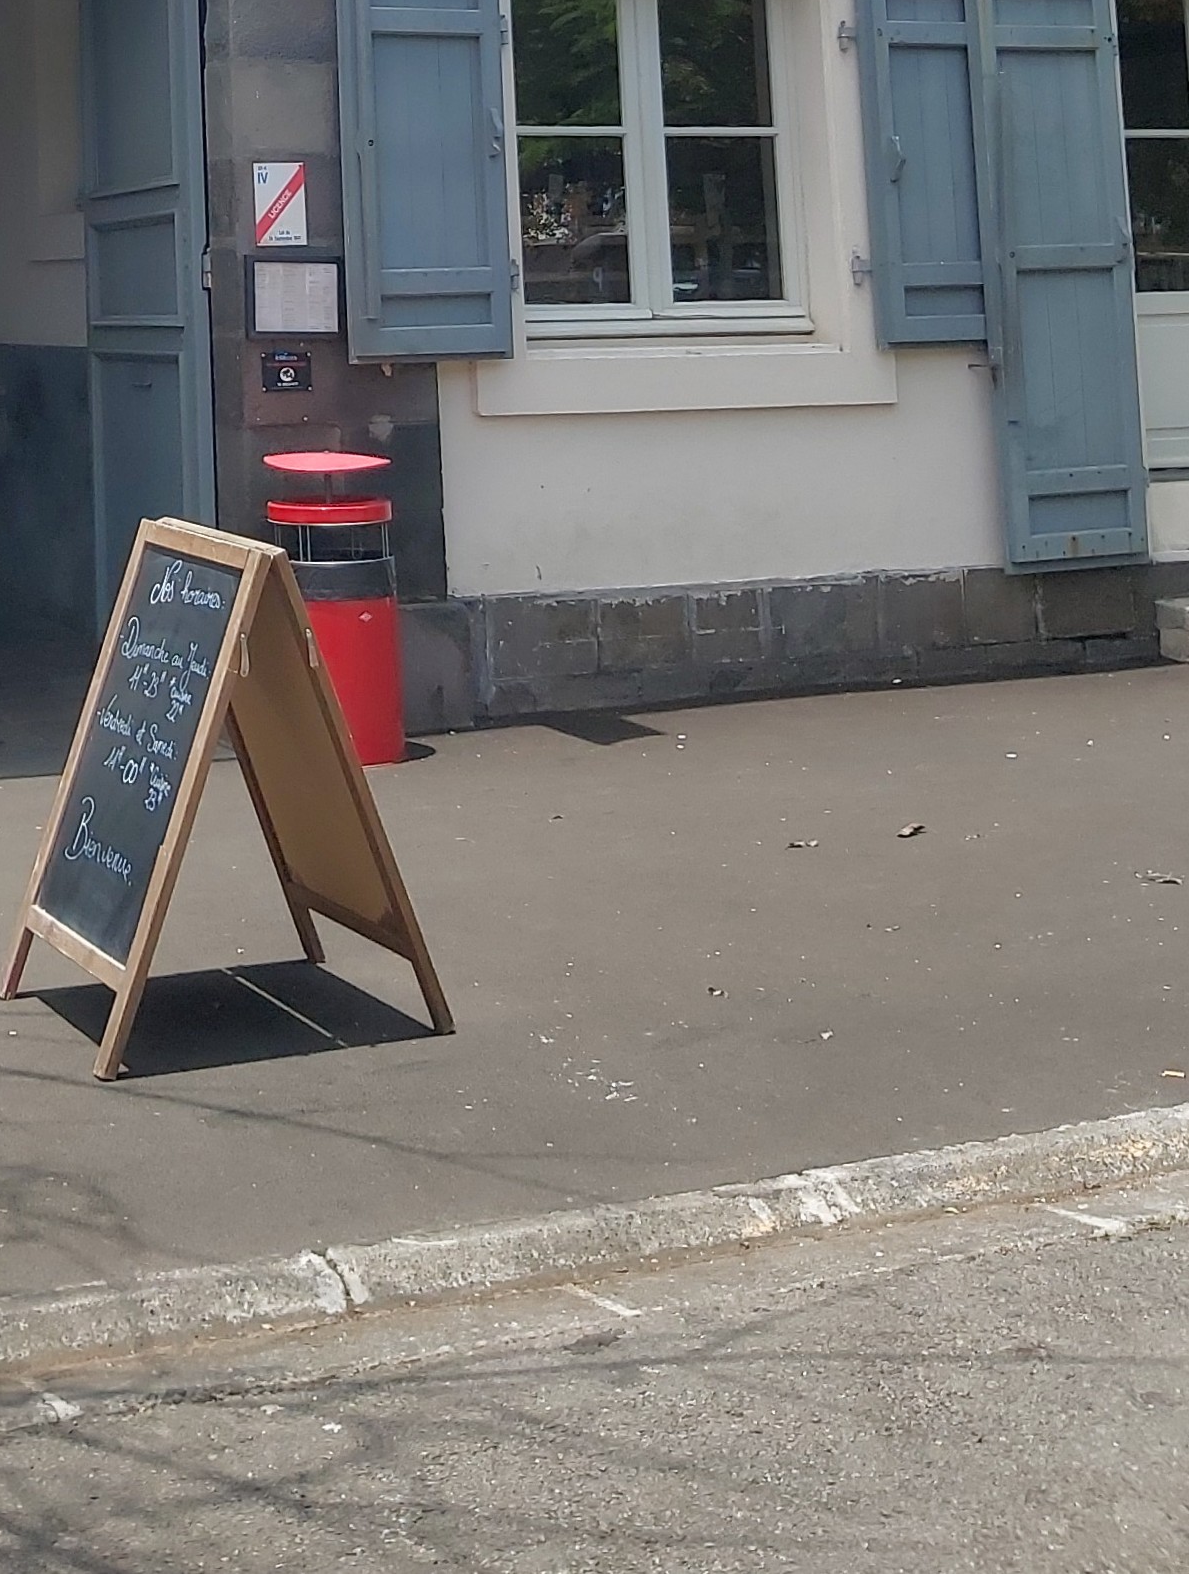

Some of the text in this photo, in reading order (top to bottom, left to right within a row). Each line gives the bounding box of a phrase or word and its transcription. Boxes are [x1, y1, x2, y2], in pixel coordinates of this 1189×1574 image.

[257, 171, 269, 184] IV
[268, 188, 293, 219] LICENCE
[150, 559, 183, 605] Nos
